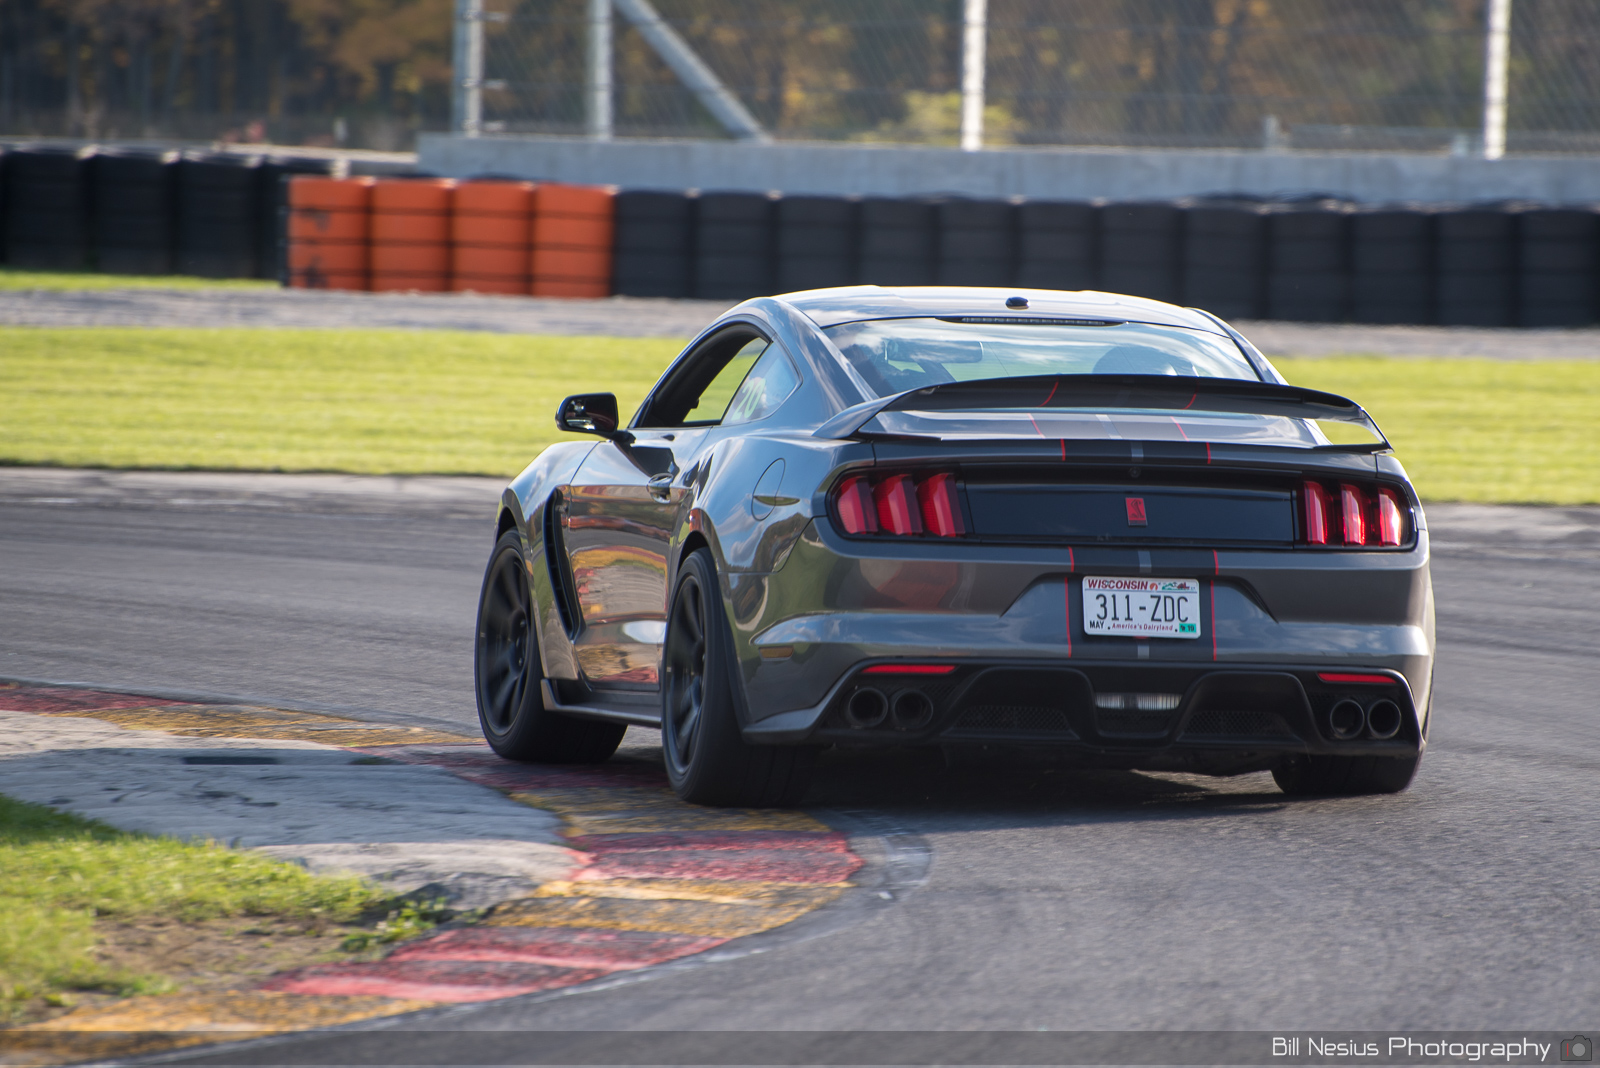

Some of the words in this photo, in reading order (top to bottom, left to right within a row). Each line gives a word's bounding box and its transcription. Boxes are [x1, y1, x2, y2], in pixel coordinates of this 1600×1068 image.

[731, 378, 766, 421] 20
[1088, 579, 1149, 590] WISCONSIN
[1095, 593, 1189, 623] 311-ZDC
[1089, 620, 1104, 629] MAY
[1112, 622, 1143, 631] America's
[1143, 623, 1174, 632] Dairyland
